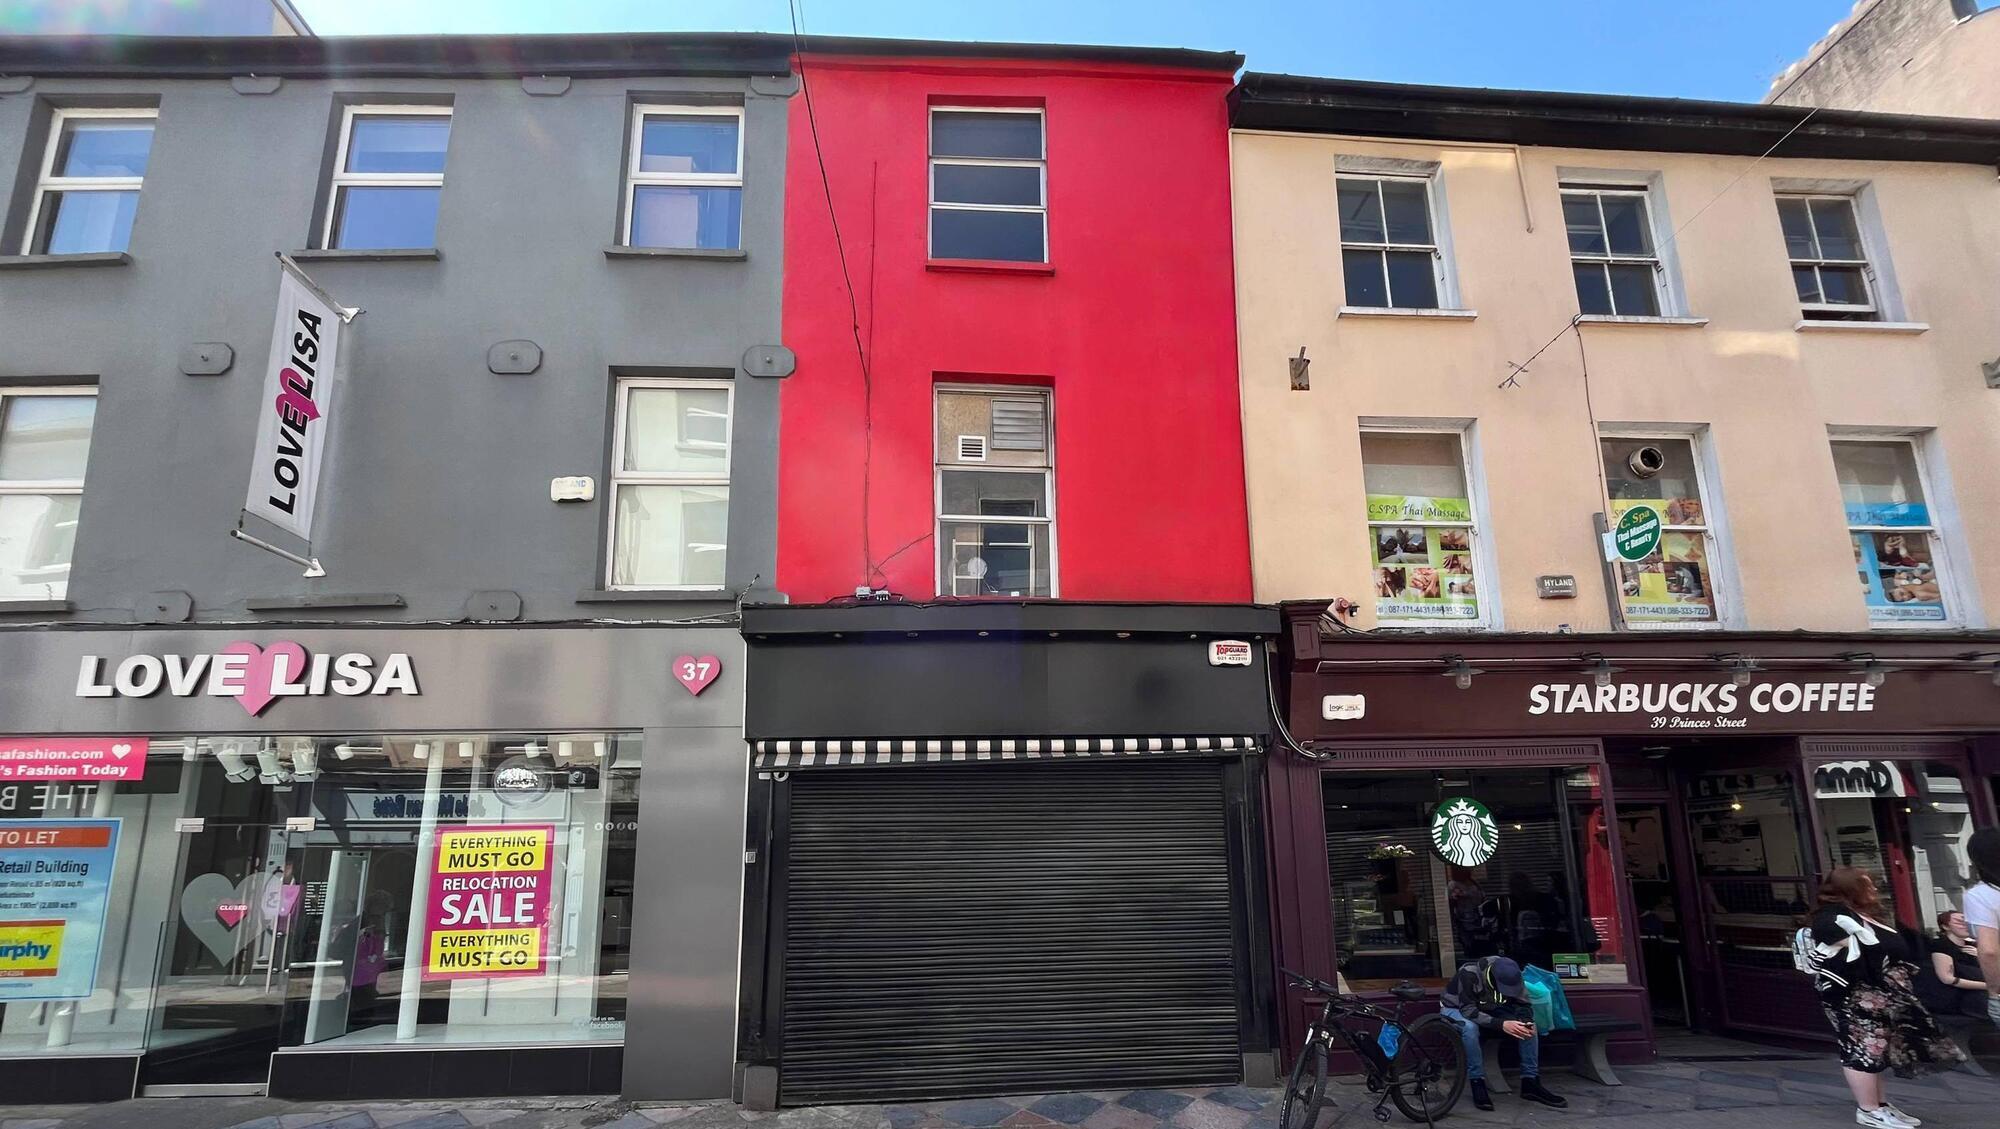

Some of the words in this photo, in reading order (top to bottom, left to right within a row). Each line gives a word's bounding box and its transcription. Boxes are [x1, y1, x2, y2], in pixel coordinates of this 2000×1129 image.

[287, 308, 322, 400] LISA
[269, 402, 309, 515] LOVE
[1402, 503, 1423, 516] Thai
[1426, 506, 1465, 521] Massage
[1632, 510, 1650, 524] Spa
[1544, 579, 1573, 587] HYLAND
[75, 653, 250, 698] LOVE
[269, 652, 420, 696] LISA
[682, 662, 711, 681] 37
[1528, 683, 1738, 715] STARBUCKS
[1750, 682, 1876, 713] COFFEE
[1650, 716, 1667, 729] 39
[1669, 716, 1711, 728] Princes
[1714, 715, 1747, 728] Street
[17, 764, 77, 776] Fashion
[82, 764, 129, 778] Today
[24, 830, 60, 845] LET
[450, 836, 537, 849] EVERYTHING
[35, 860, 90, 876] Building
[448, 853, 502, 869] MUST
[506, 851, 535, 867] GO
[442, 876, 537, 891] RELOCATION
[440, 892, 536, 926] SALE
[440, 934, 530, 948] EVERYTHING
[439, 951, 496, 968] MUST
[499, 950, 529, 966] GO
